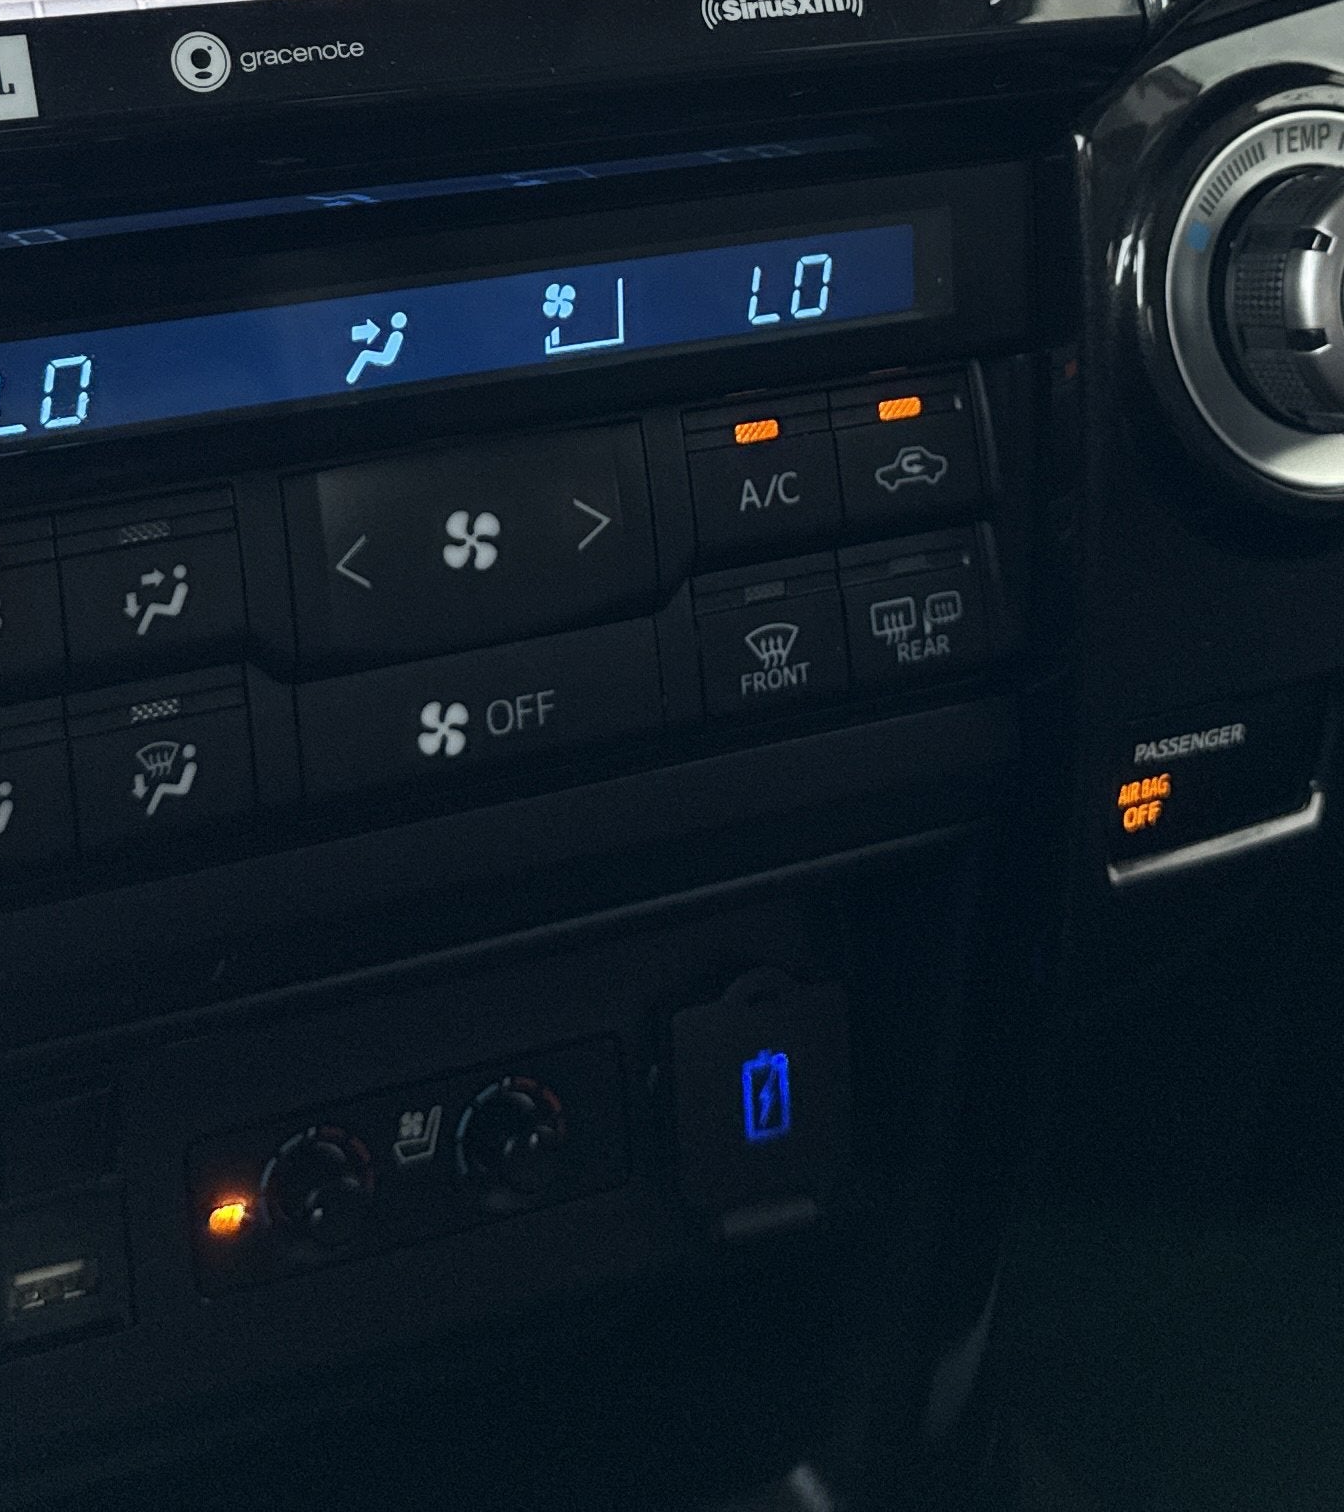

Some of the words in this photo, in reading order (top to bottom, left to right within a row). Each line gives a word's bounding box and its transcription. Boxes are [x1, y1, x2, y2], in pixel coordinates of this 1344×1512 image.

[240, 39, 365, 72] gracenote
[1272, 122, 1332, 157] TEMP
[739, 471, 801, 513] A/C
[896, 634, 951, 664] REAR
[740, 662, 812, 695] FRONT
[486, 689, 556, 737] OFF
[1133, 722, 1247, 765] PASSENGER
[1123, 800, 1163, 833] OFF
